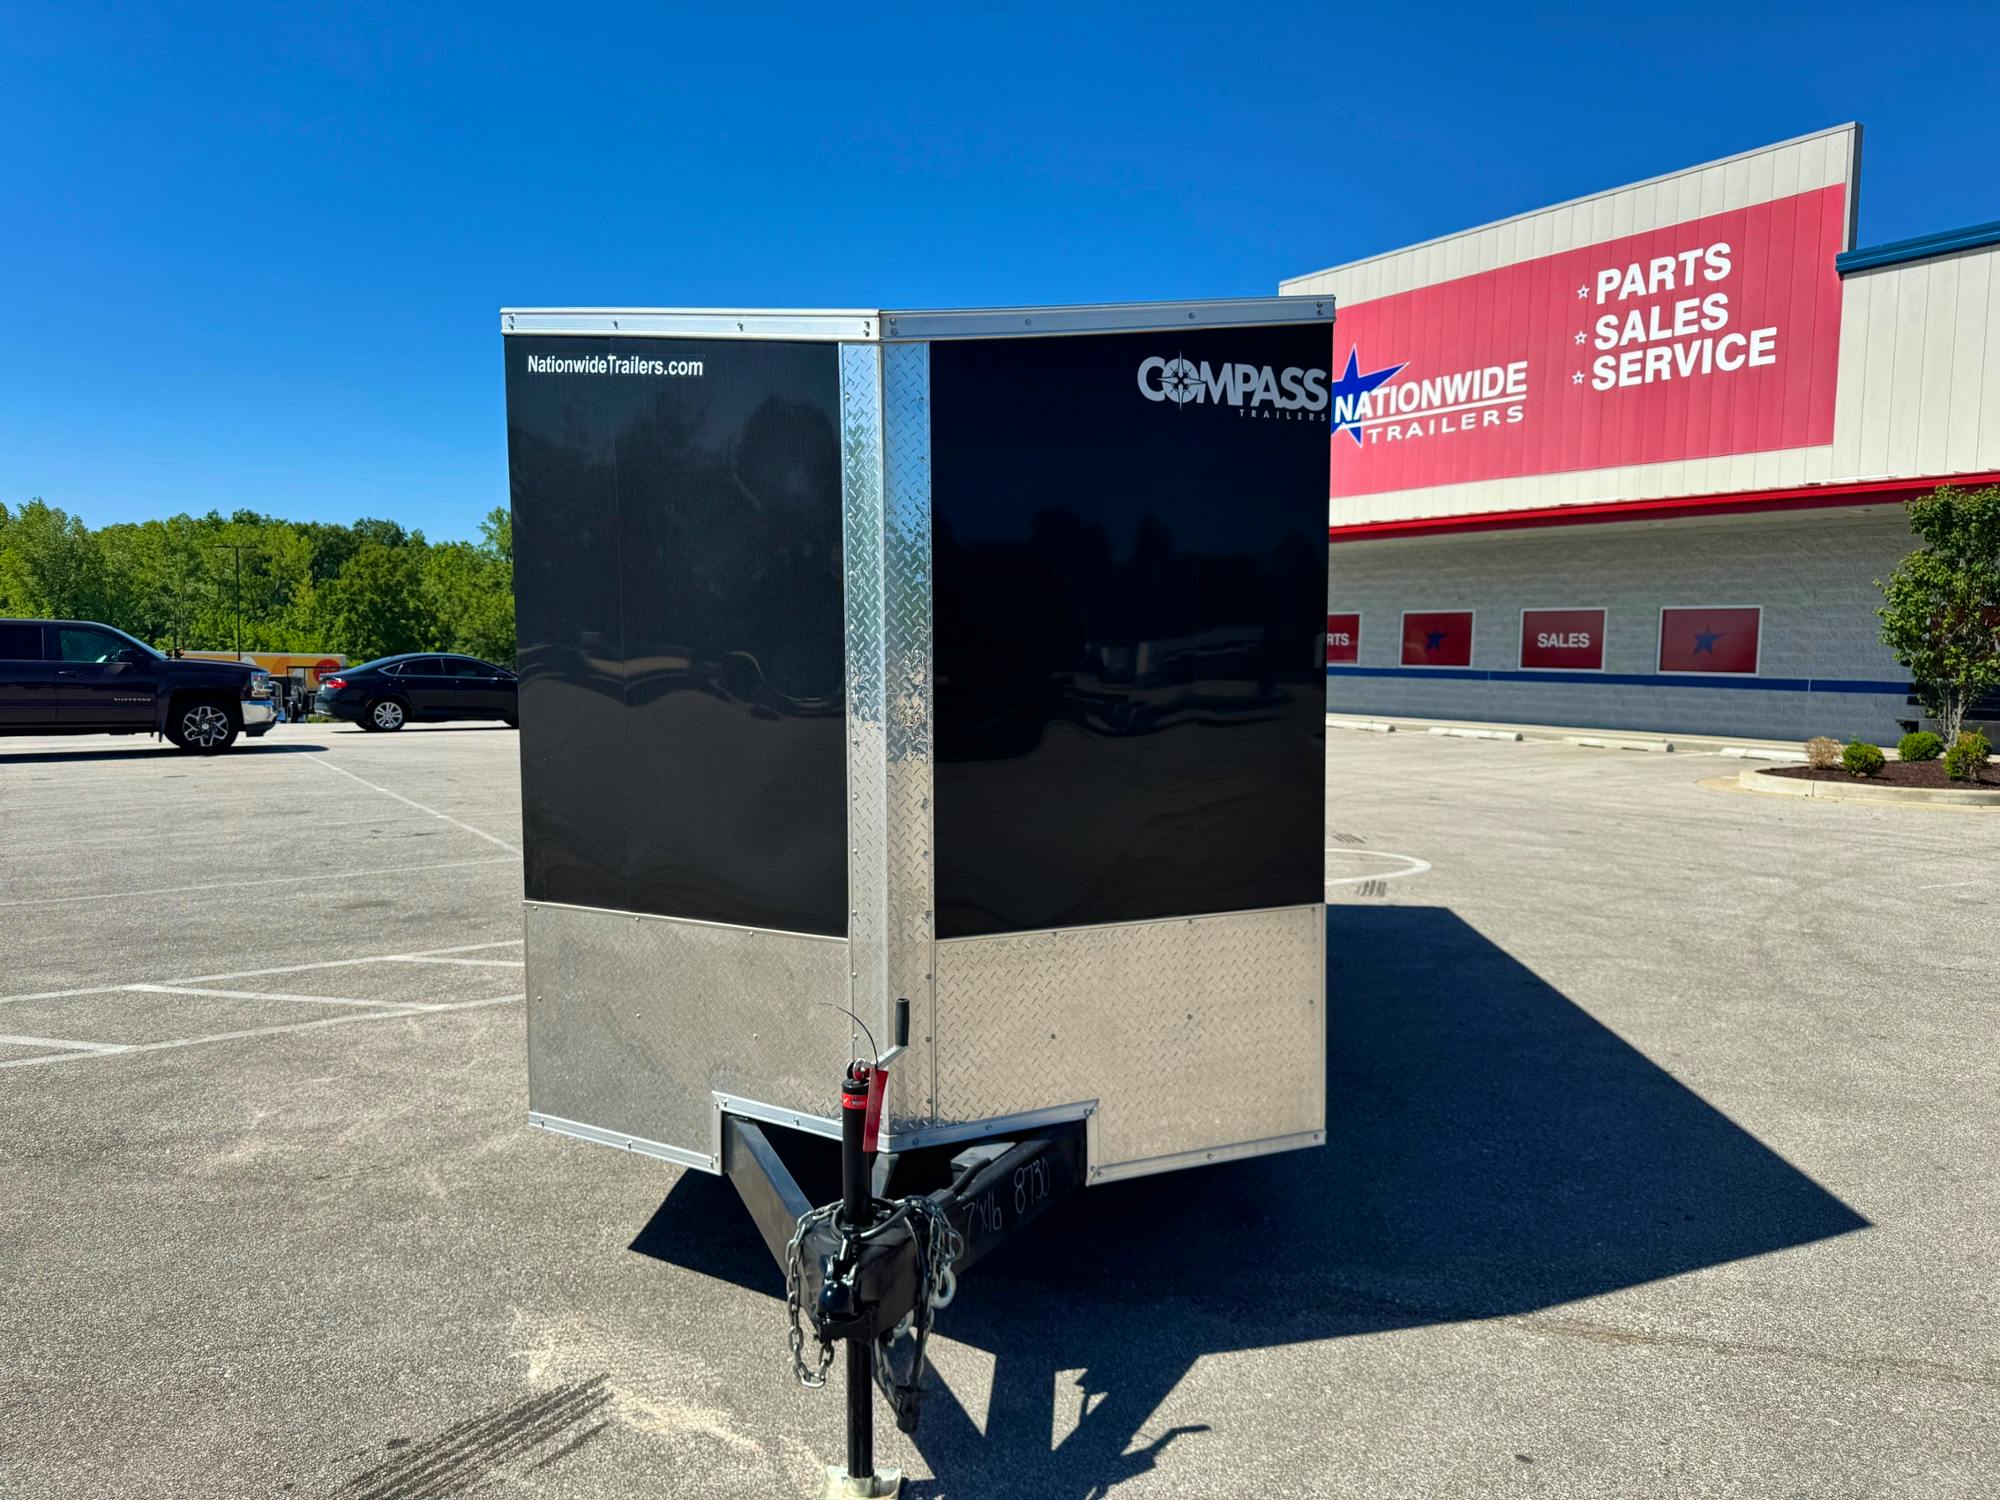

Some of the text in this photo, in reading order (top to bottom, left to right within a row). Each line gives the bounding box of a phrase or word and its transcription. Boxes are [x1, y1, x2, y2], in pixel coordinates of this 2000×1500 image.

[1596, 242, 1732, 304] PARTS
[1594, 292, 1729, 350] SALES
[527, 355, 703, 376] NationwideTrailers.com
[1137, 354, 1329, 412] COMPASS
[1591, 326, 1778, 391] SERVICE
[1239, 408, 1327, 422] TRAILERS
[1334, 361, 1528, 423] NATIONWIDE
[1366, 405, 1525, 445] TRAILERS
[1327, 633, 1350, 646] RTS
[1537, 632, 1590, 648] SALES
[1014, 1156, 1050, 1215] 8730
